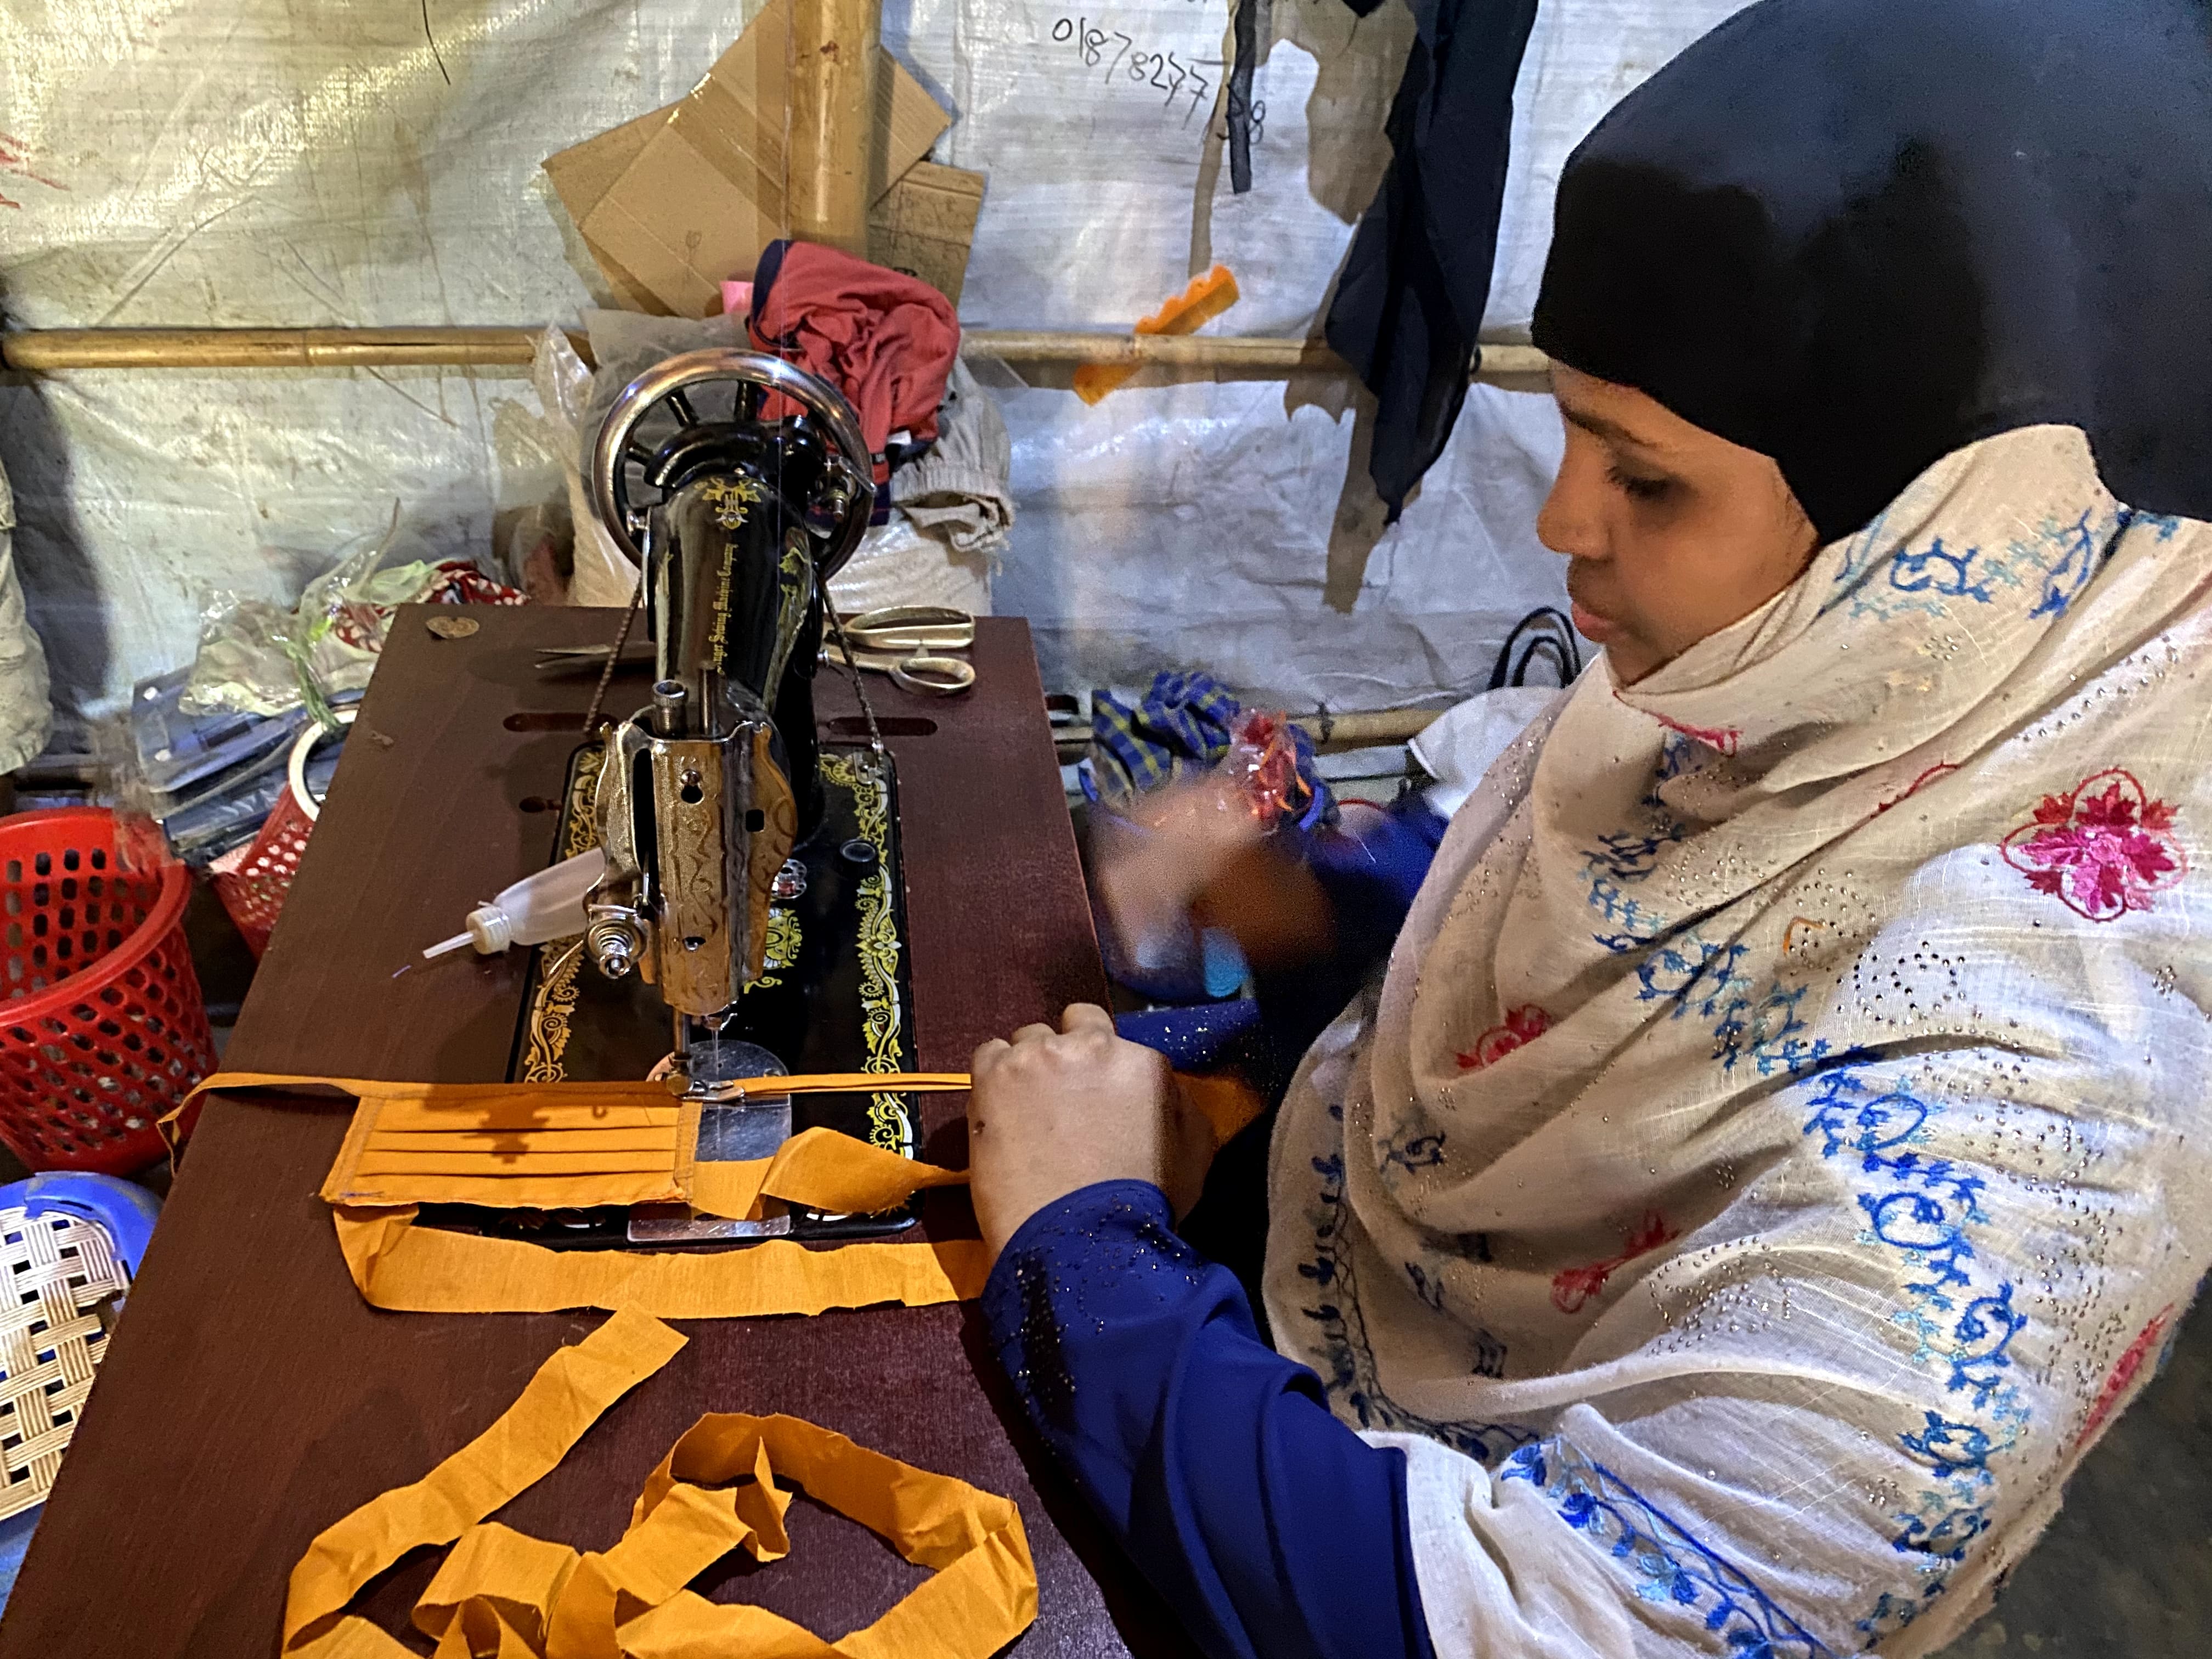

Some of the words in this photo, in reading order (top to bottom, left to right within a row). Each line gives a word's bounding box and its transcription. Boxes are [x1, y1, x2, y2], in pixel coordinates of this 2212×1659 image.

[716, 543, 739, 576] Company
[713, 577, 733, 612] Machine
[708, 613, 732, 645] Sewing
